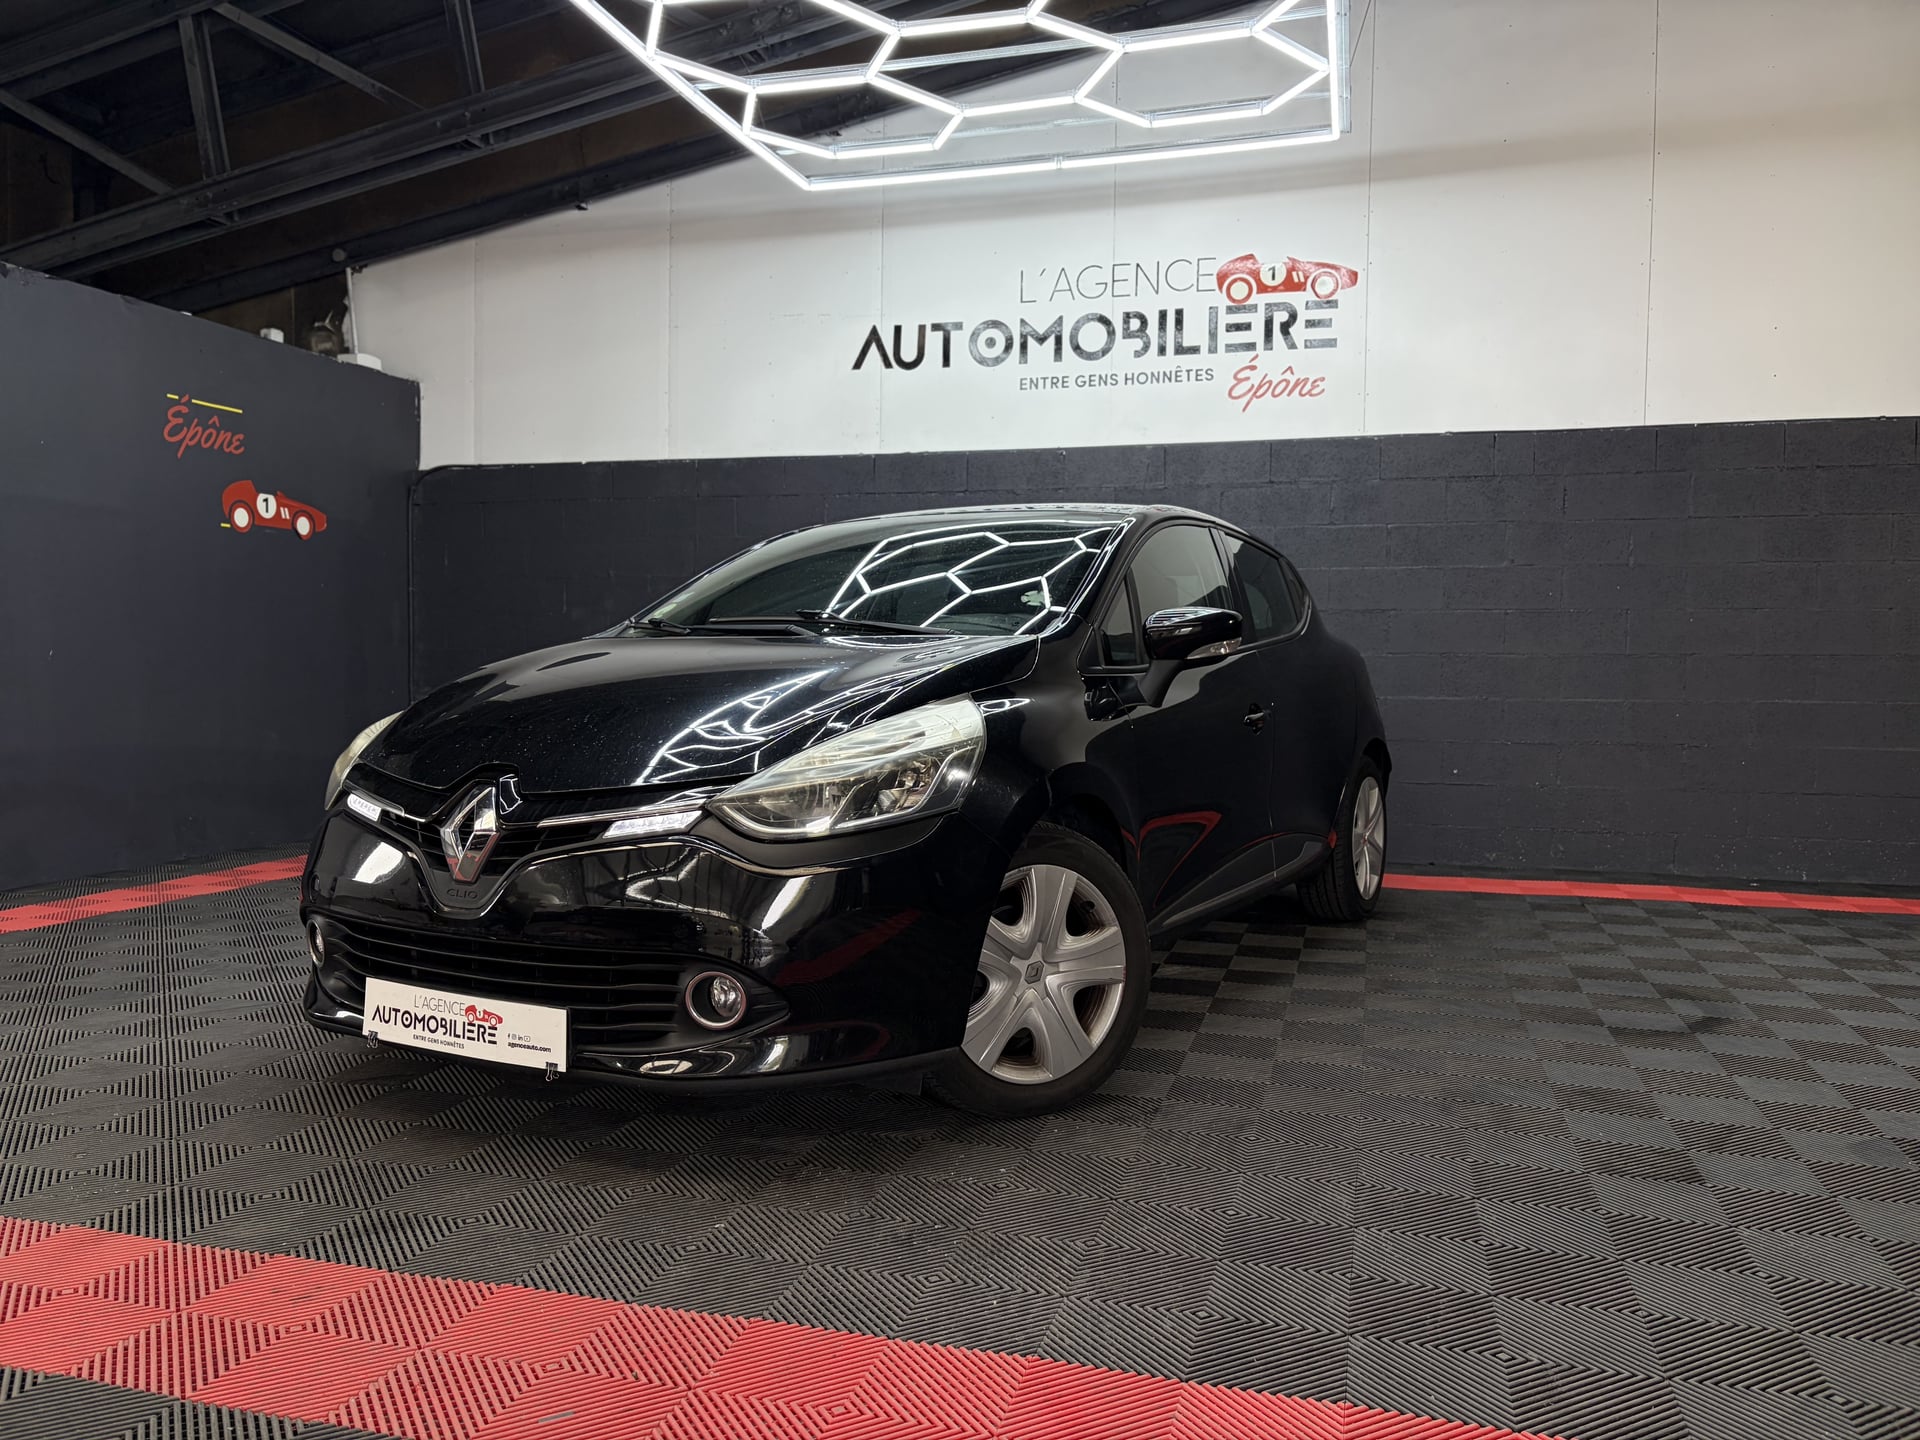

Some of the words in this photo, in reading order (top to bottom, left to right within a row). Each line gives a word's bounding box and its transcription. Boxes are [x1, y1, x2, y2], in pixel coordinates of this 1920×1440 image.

[1020, 257, 1216, 304] L'AGENCE
[1267, 265, 1277, 282] 1
[1019, 374, 1070, 391] ENTRE
[1074, 371, 1119, 389] GENS
[1123, 366, 1215, 387] HONNÊTES
[1227, 354, 1326, 413] Épône
[163, 394, 245, 459] Épône
[262, 497, 270, 513] 1
[446, 888, 479, 900] CLIO
[414, 994, 466, 1017] L'AGENCE
[412, 1034, 427, 1043] ENTRE
[427, 1037, 440, 1045] GENS
[440, 1038, 465, 1050] HONNÊTES
[507, 1041, 552, 1053] agenceauto.com
